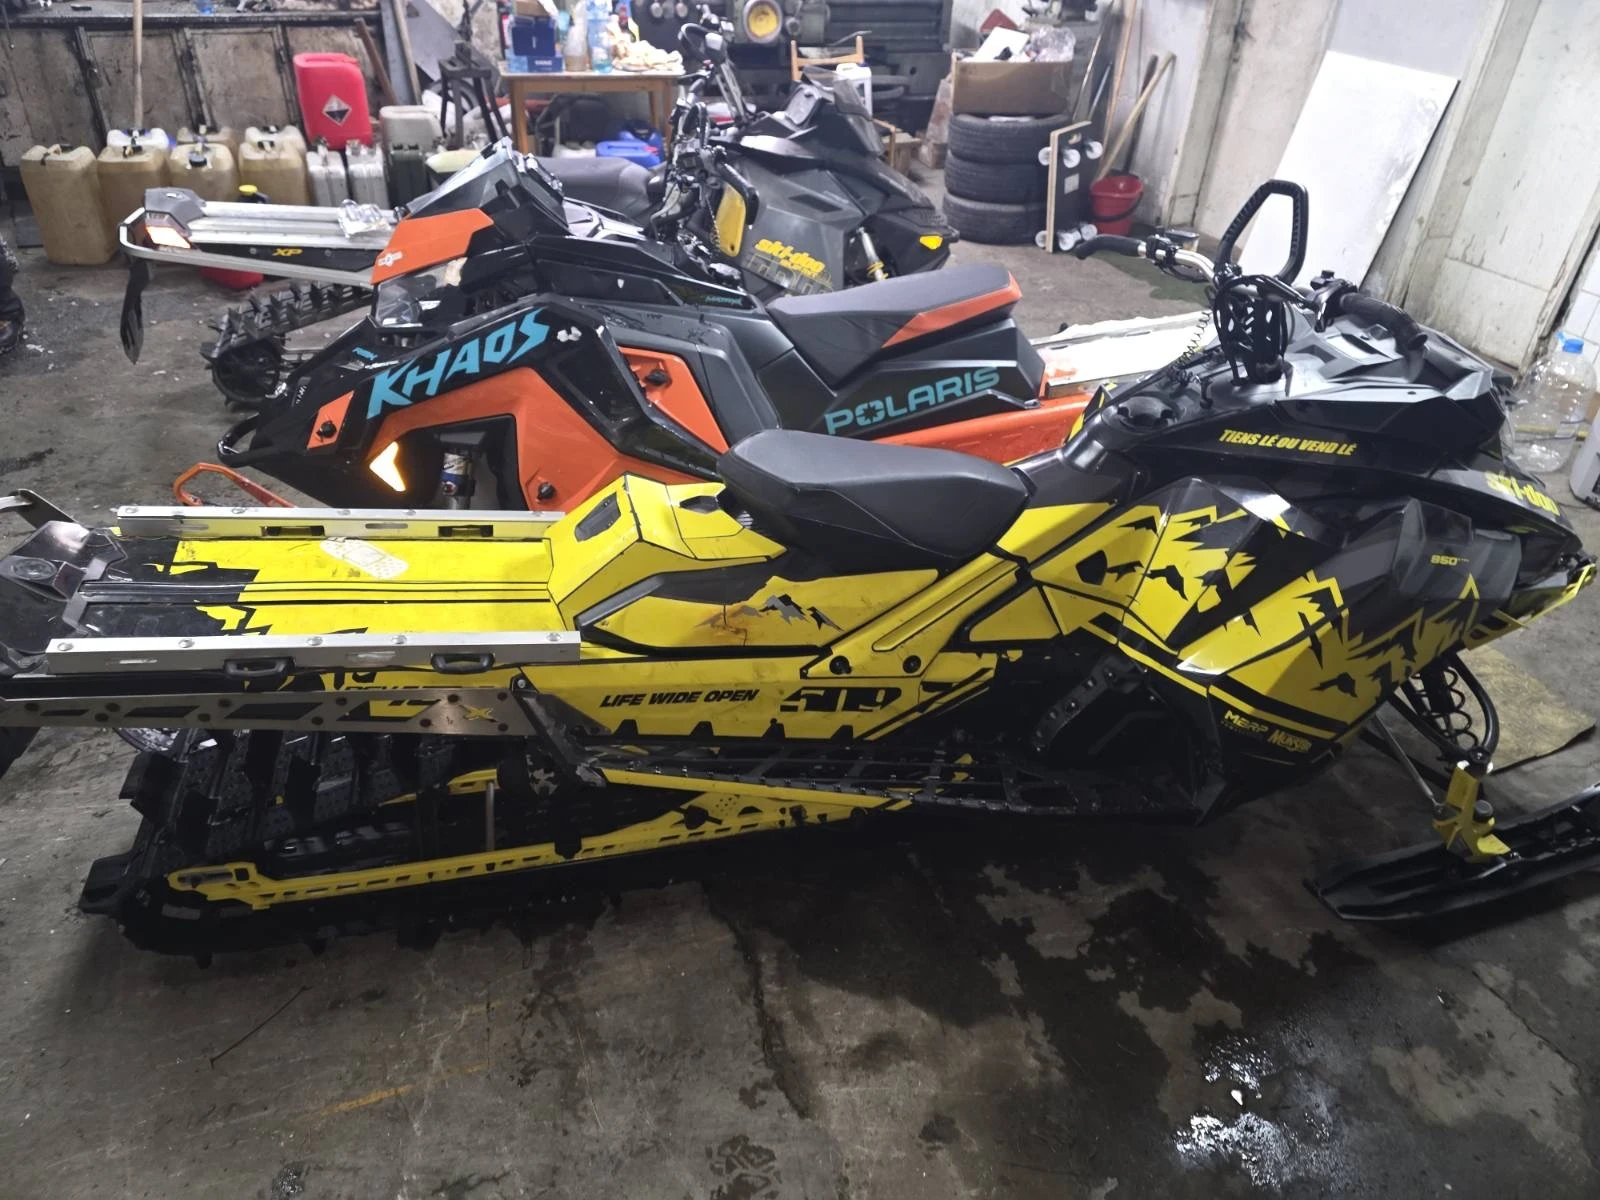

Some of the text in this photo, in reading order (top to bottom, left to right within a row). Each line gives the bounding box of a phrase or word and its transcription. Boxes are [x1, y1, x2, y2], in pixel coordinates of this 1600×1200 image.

[272, 247, 303, 256] XP
[366, 306, 550, 420] KHAOS
[824, 366, 1000, 435] POLARIS
[1219, 429, 1261, 446] TIENS
[1276, 437, 1300, 449] OU
[1298, 439, 1338, 454] VEND
[1431, 554, 1458, 566] 850
[600, 688, 760, 708] LIFE WIDE OPEN
